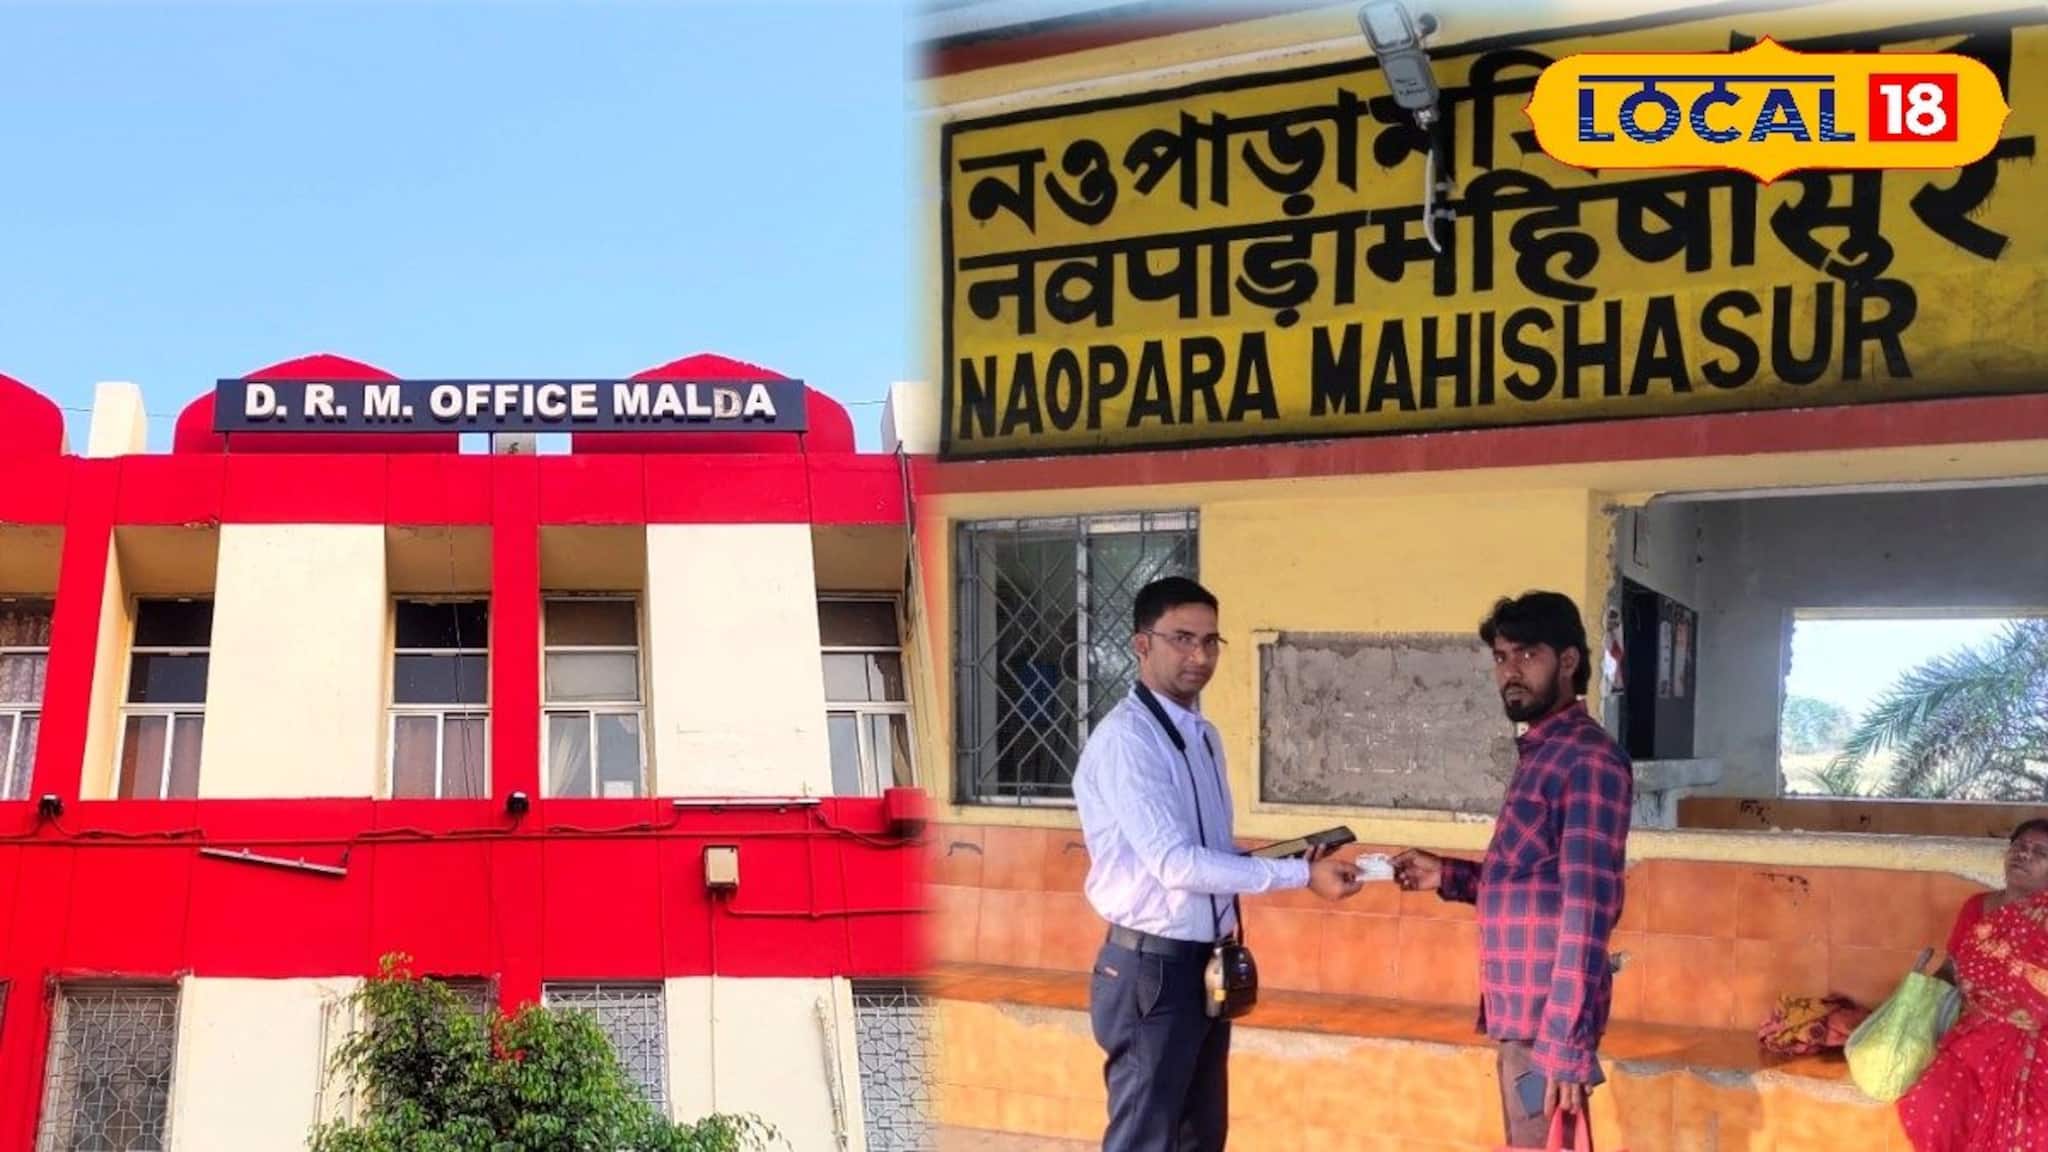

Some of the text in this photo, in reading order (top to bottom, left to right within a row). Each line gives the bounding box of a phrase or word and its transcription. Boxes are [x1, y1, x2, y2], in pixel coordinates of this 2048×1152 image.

[245, 383, 777, 419] D. R. M. OFFICE MALDA
[958, 278, 1918, 440] NAOPARA MAHISHASUR
